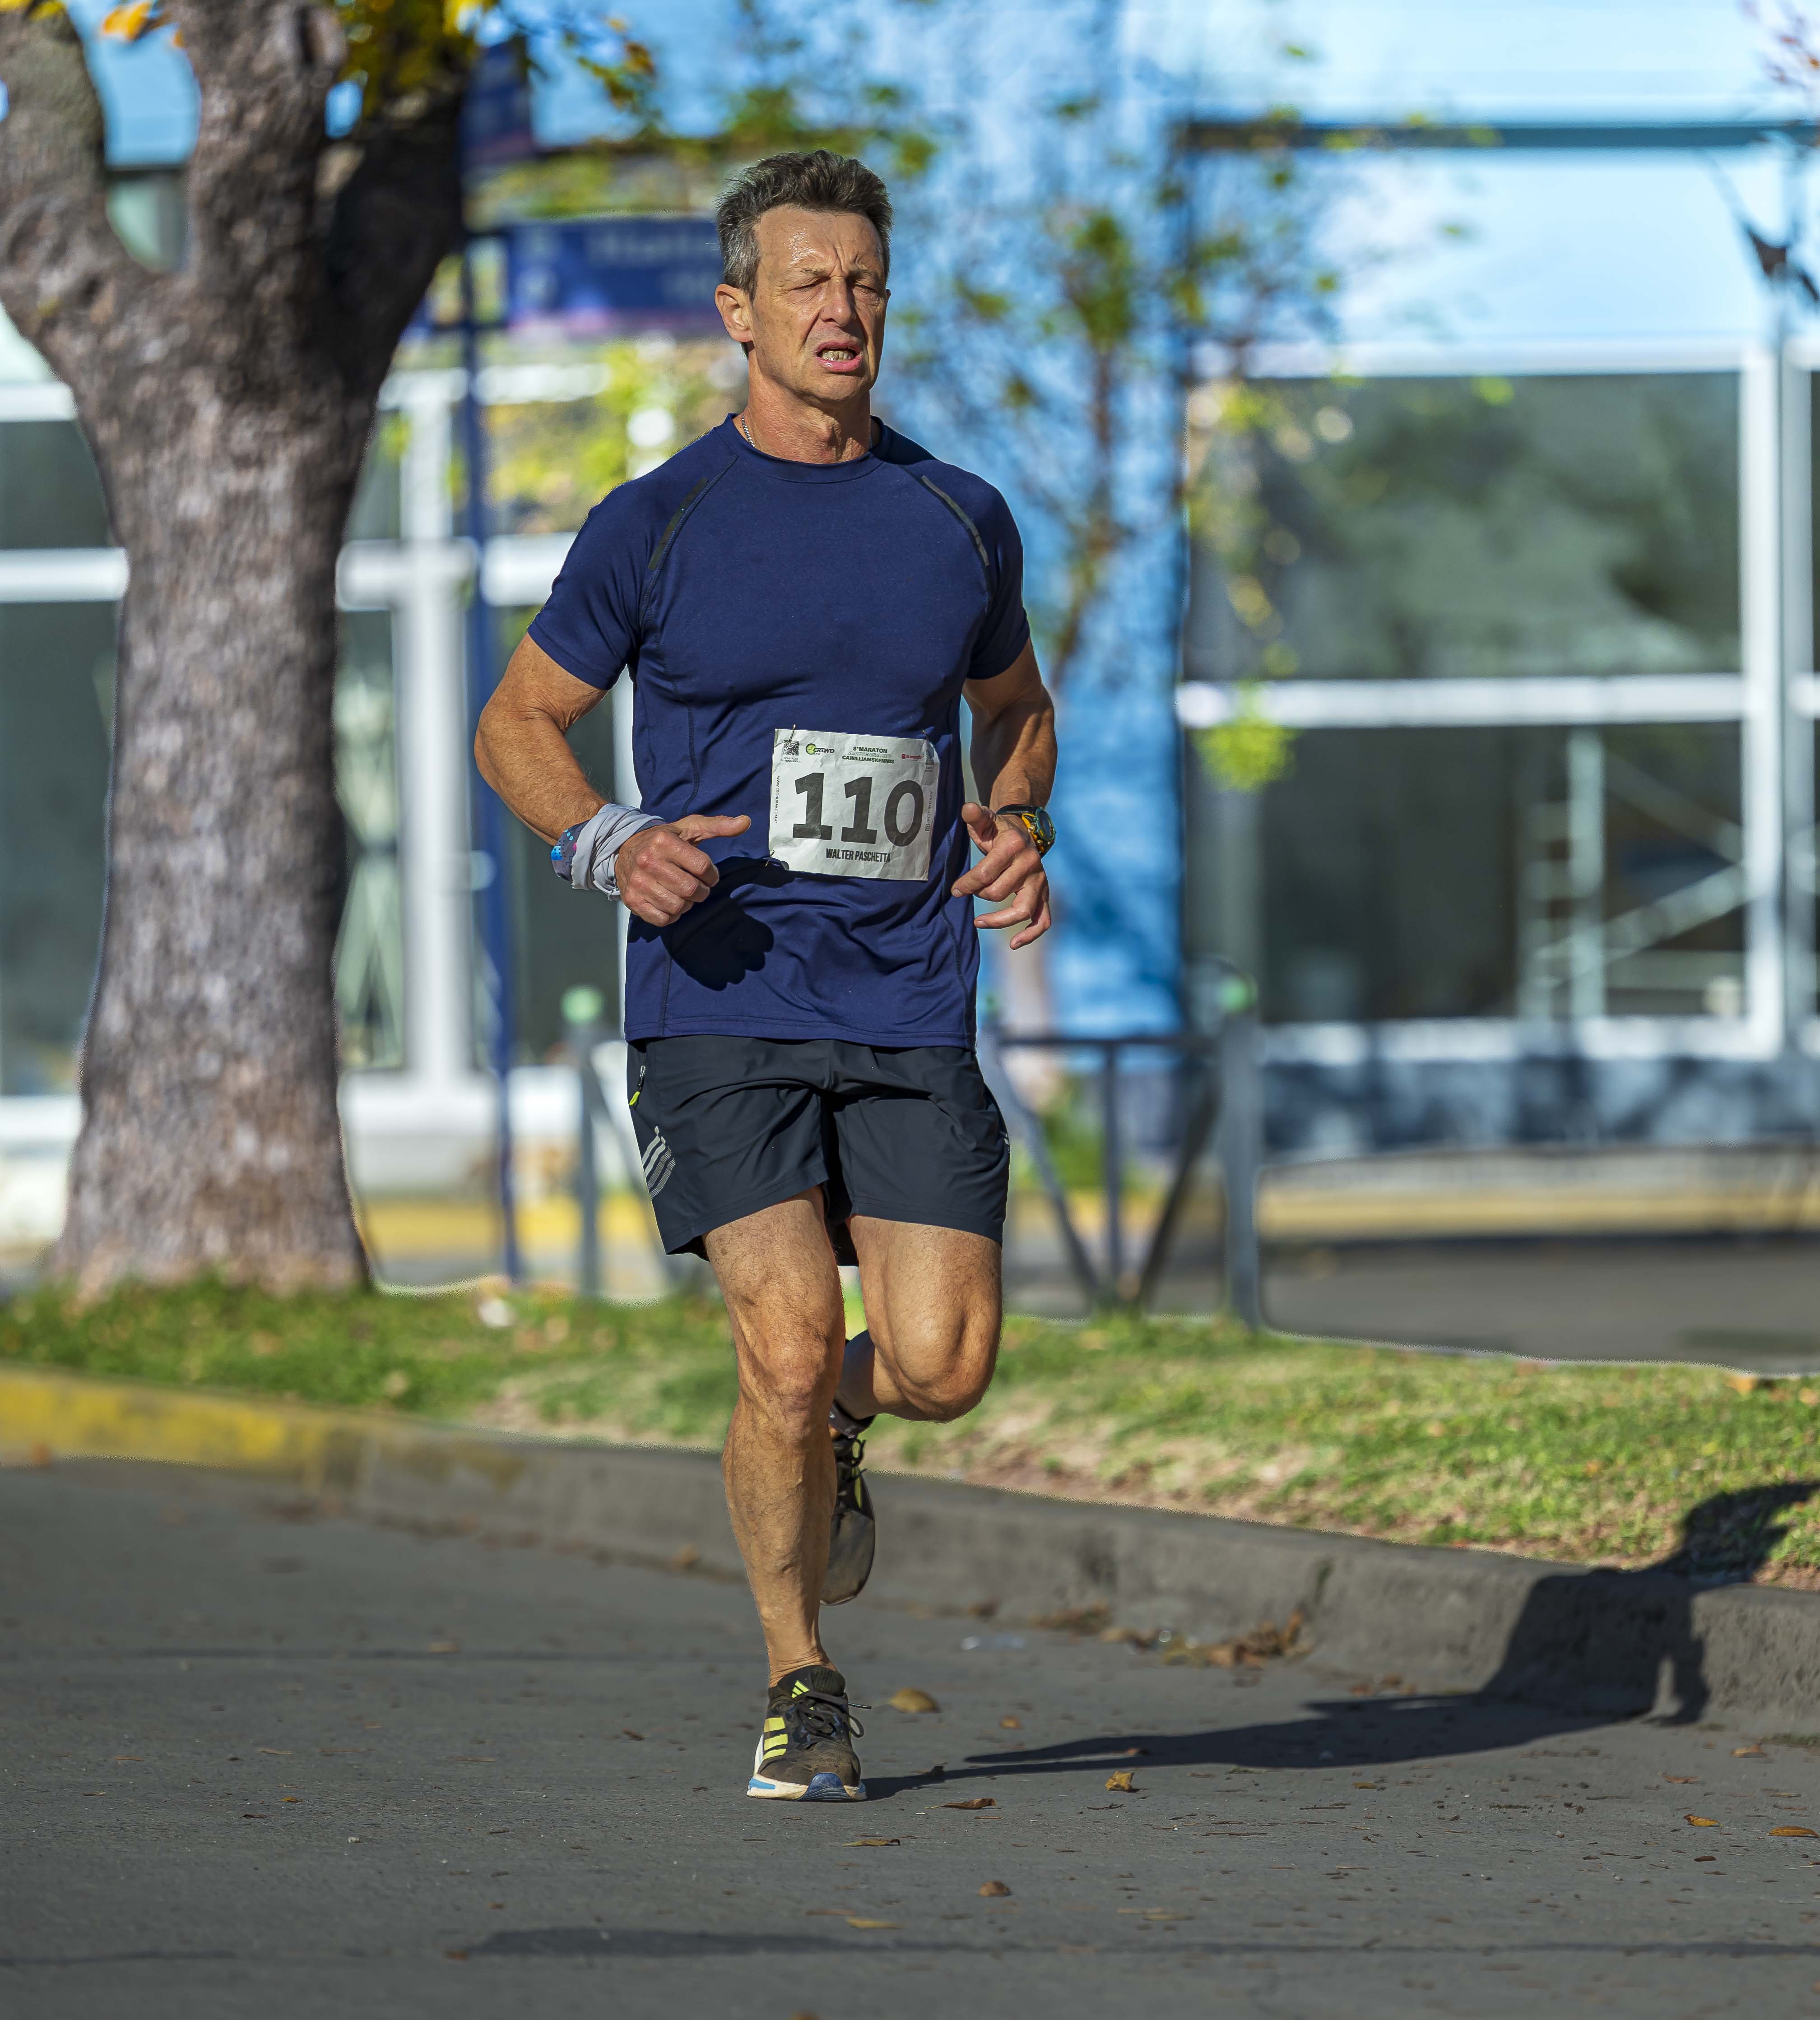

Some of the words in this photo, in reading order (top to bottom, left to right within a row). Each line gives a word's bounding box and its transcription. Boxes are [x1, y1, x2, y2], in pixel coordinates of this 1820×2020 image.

[793, 772, 924, 847] 110
[826, 848, 854, 860] WALTER
[855, 851, 891, 862] PASCHETTA
